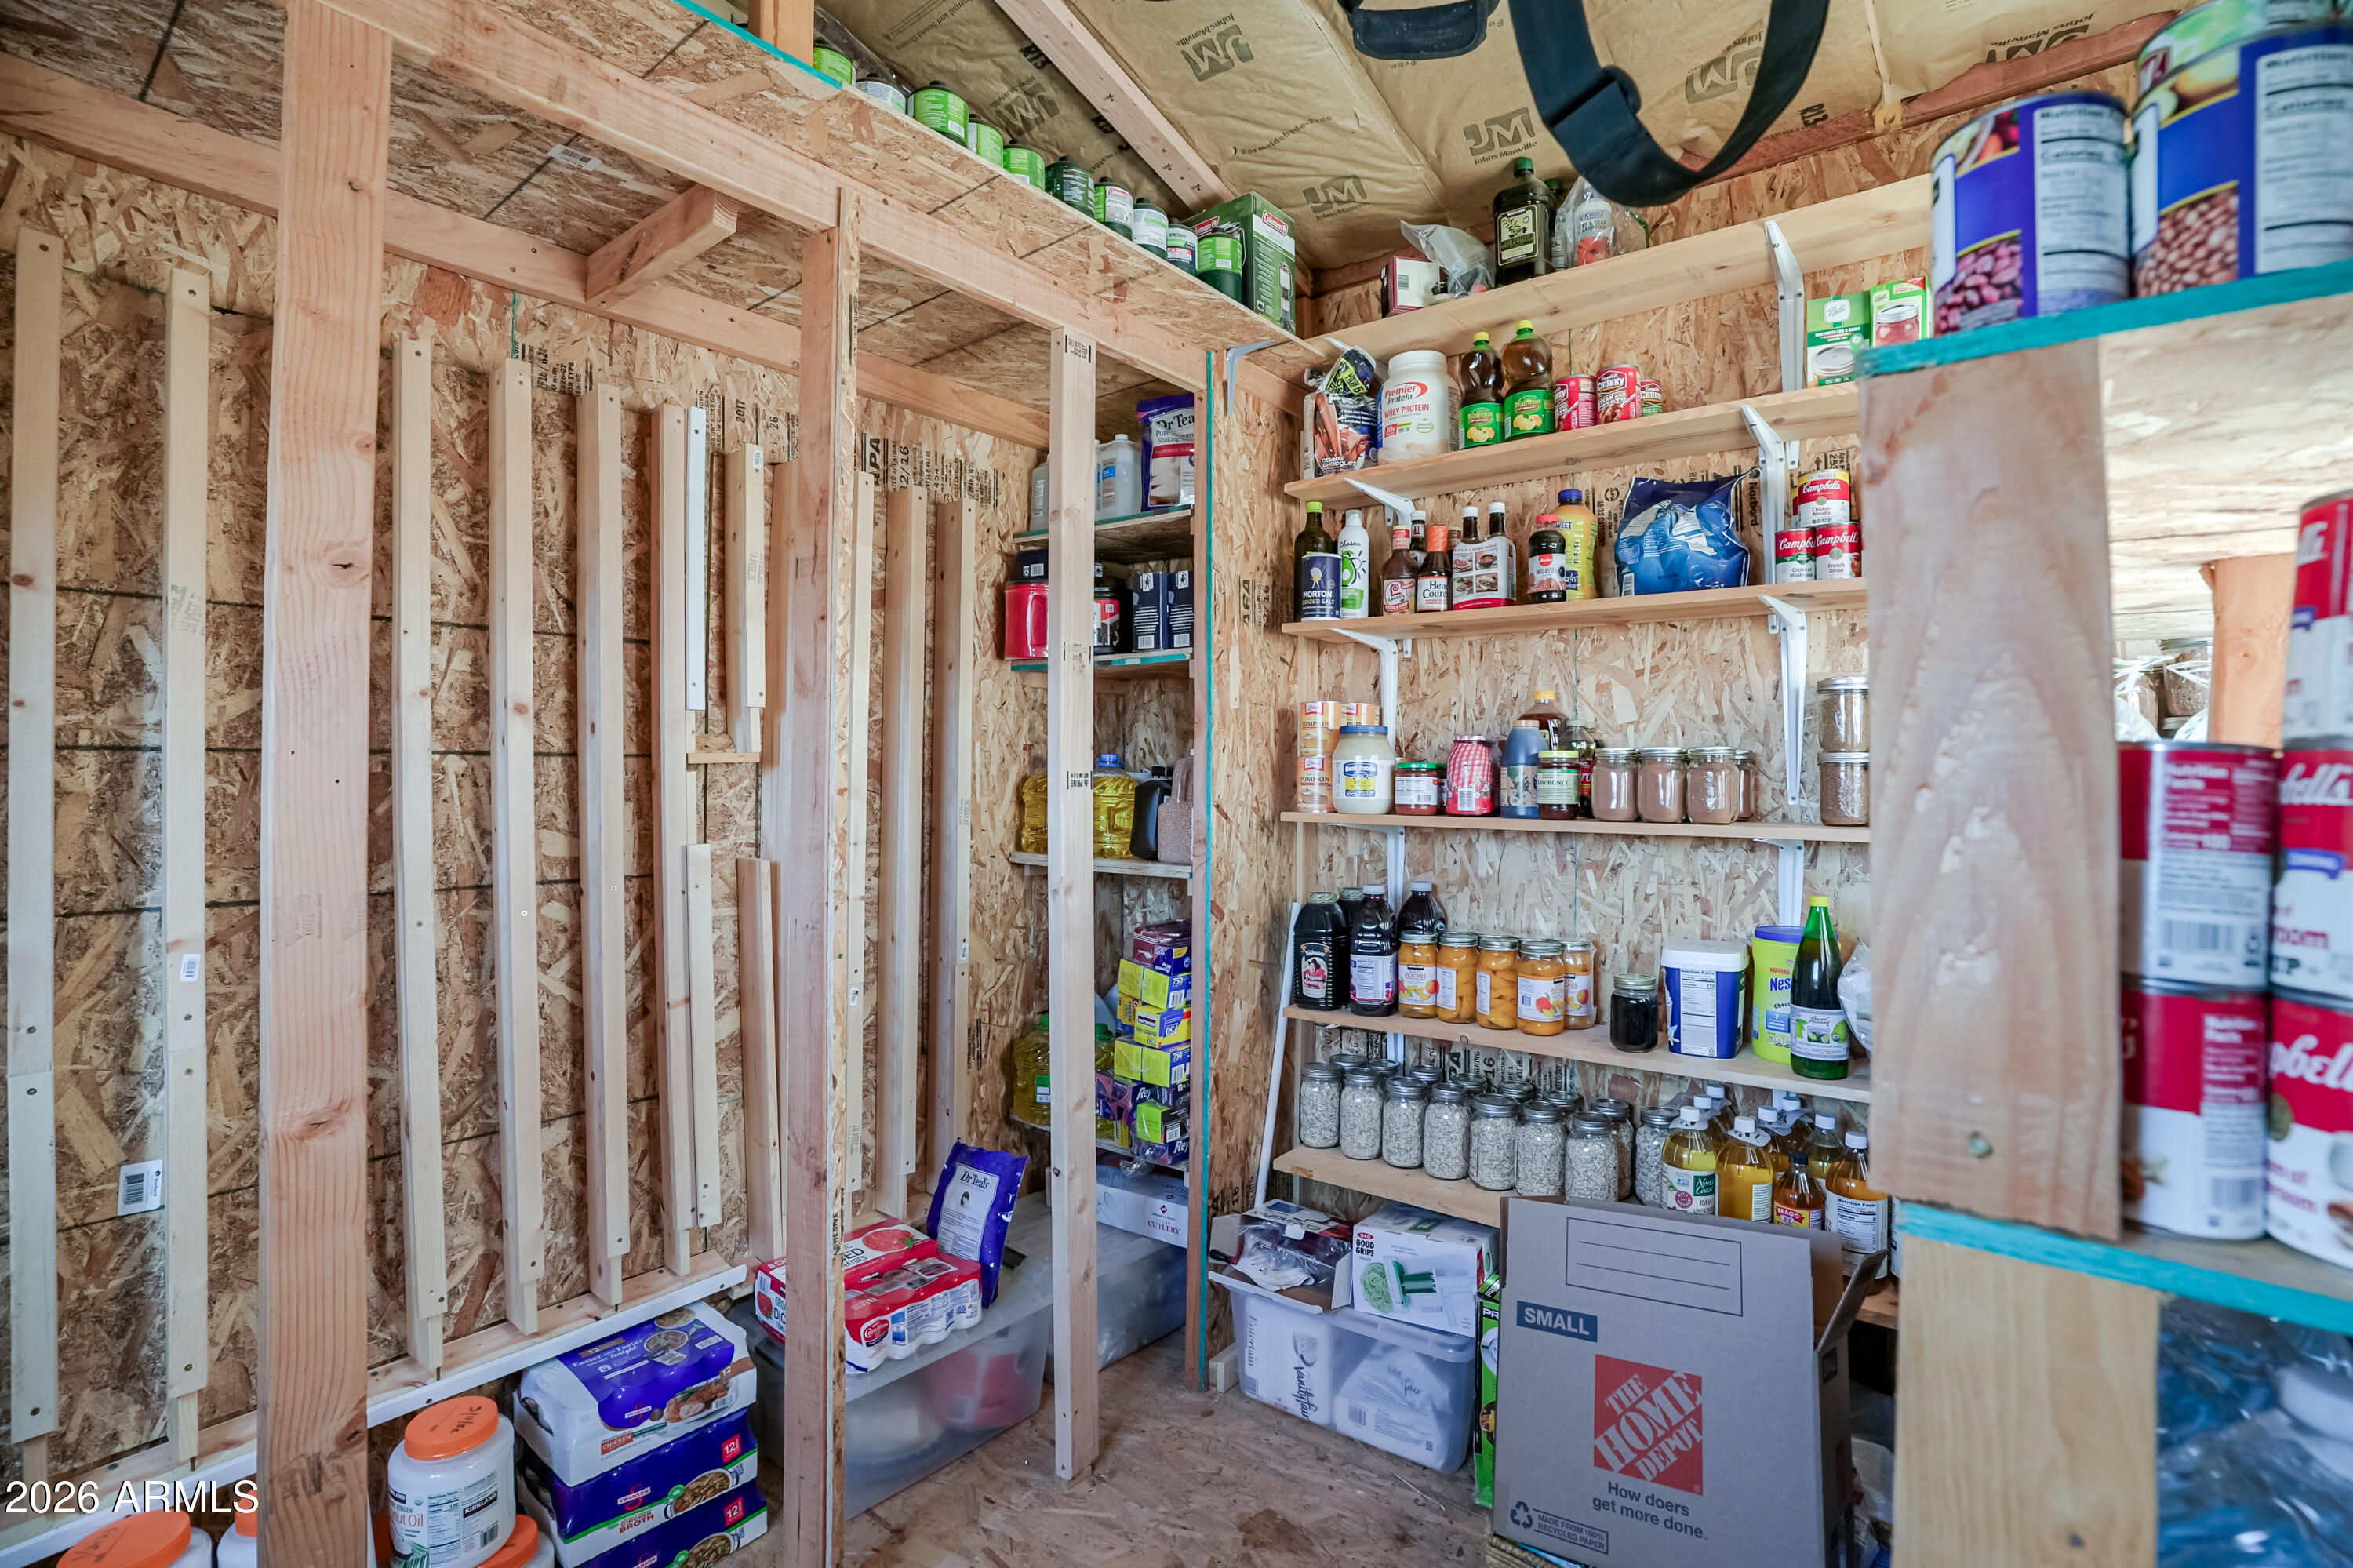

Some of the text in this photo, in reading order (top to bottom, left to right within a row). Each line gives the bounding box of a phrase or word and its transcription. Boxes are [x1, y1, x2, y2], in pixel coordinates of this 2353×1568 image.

[1176, 12, 1235, 47] Johns Manville
[1990, 11, 2097, 47] Johns Manville
[1731, 31, 1764, 48] Johns
[1180, 24, 1254, 82] JM
[1240, 115, 1333, 155] Formaldehyde-Free
[1463, 107, 1536, 157] JM
[1473, 141, 1538, 166] Johns Manville
[1384, 384, 1417, 399] Premier
[1597, 377, 1625, 391] CHUNKY
[1387, 394, 1413, 406] Protein
[1612, 391, 1627, 400] AND
[735, 398, 746, 424] 2017
[1384, 407, 1400, 419] WHEY
[1401, 403, 1430, 414] PROTEIN
[769, 416, 779, 431] 26
[1173, 413, 1195, 428] Tea
[1802, 479, 1842, 494] Campbell's
[1748, 481, 1760, 527] Norbord
[1555, 522, 1573, 530] WEET
[1339, 539, 1362, 549] Chosen
[1779, 537, 1817, 551] Campbe
[1816, 531, 1859, 547] Campbell's
[1303, 589, 1333, 598] MORTON
[1172, 976, 1184, 987] 750
[1166, 1024, 1179, 1036] 750
[1172, 1051, 1184, 1061] 750
[959, 1170, 973, 1184] Dr
[1838, 1198, 1861, 1206] Nutrition
[1777, 1207, 1801, 1220] BRAGG
[1147, 1220, 1181, 1236] CUTLERY
[1355, 1239, 1375, 1250] GOOD
[1355, 1246, 1374, 1257] GRIPS
[1523, 1305, 1591, 1336] SMALL
[864, 1321, 889, 1339] Carnation
[1247, 1315, 1257, 1367] Entertain
[572, 1337, 644, 1369] Easier Faster
[588, 1346, 602, 1355] 12
[609, 1345, 638, 1360] Tonight
[721, 1366, 733, 1377] 12
[1604, 1373, 1649, 1417] THE
[625, 1406, 651, 1419] SWANSON
[1594, 1370, 1704, 1473] HOME
[602, 1434, 632, 1451] CHICKEN
[723, 1441, 736, 1456] 12
[1634, 1417, 1704, 1483] DEPOT
[464, 1491, 497, 1515] KIRKLAND
[618, 1488, 650, 1504] SWANSON
[1607, 1480, 1690, 1517] How doers
[395, 1504, 413, 1514] VIRGIN
[726, 1504, 739, 1519] 12
[1592, 1495, 1617, 1515] get
[1620, 1504, 1660, 1526] more
[408, 1513, 424, 1527] Oil
[619, 1514, 654, 1534] BROTH
[620, 1510, 653, 1527] CHICKEN
[1537, 1514, 1605, 1542] MADE FROM 100%
[1537, 1522, 1606, 1551] RECYCLED PAPER
